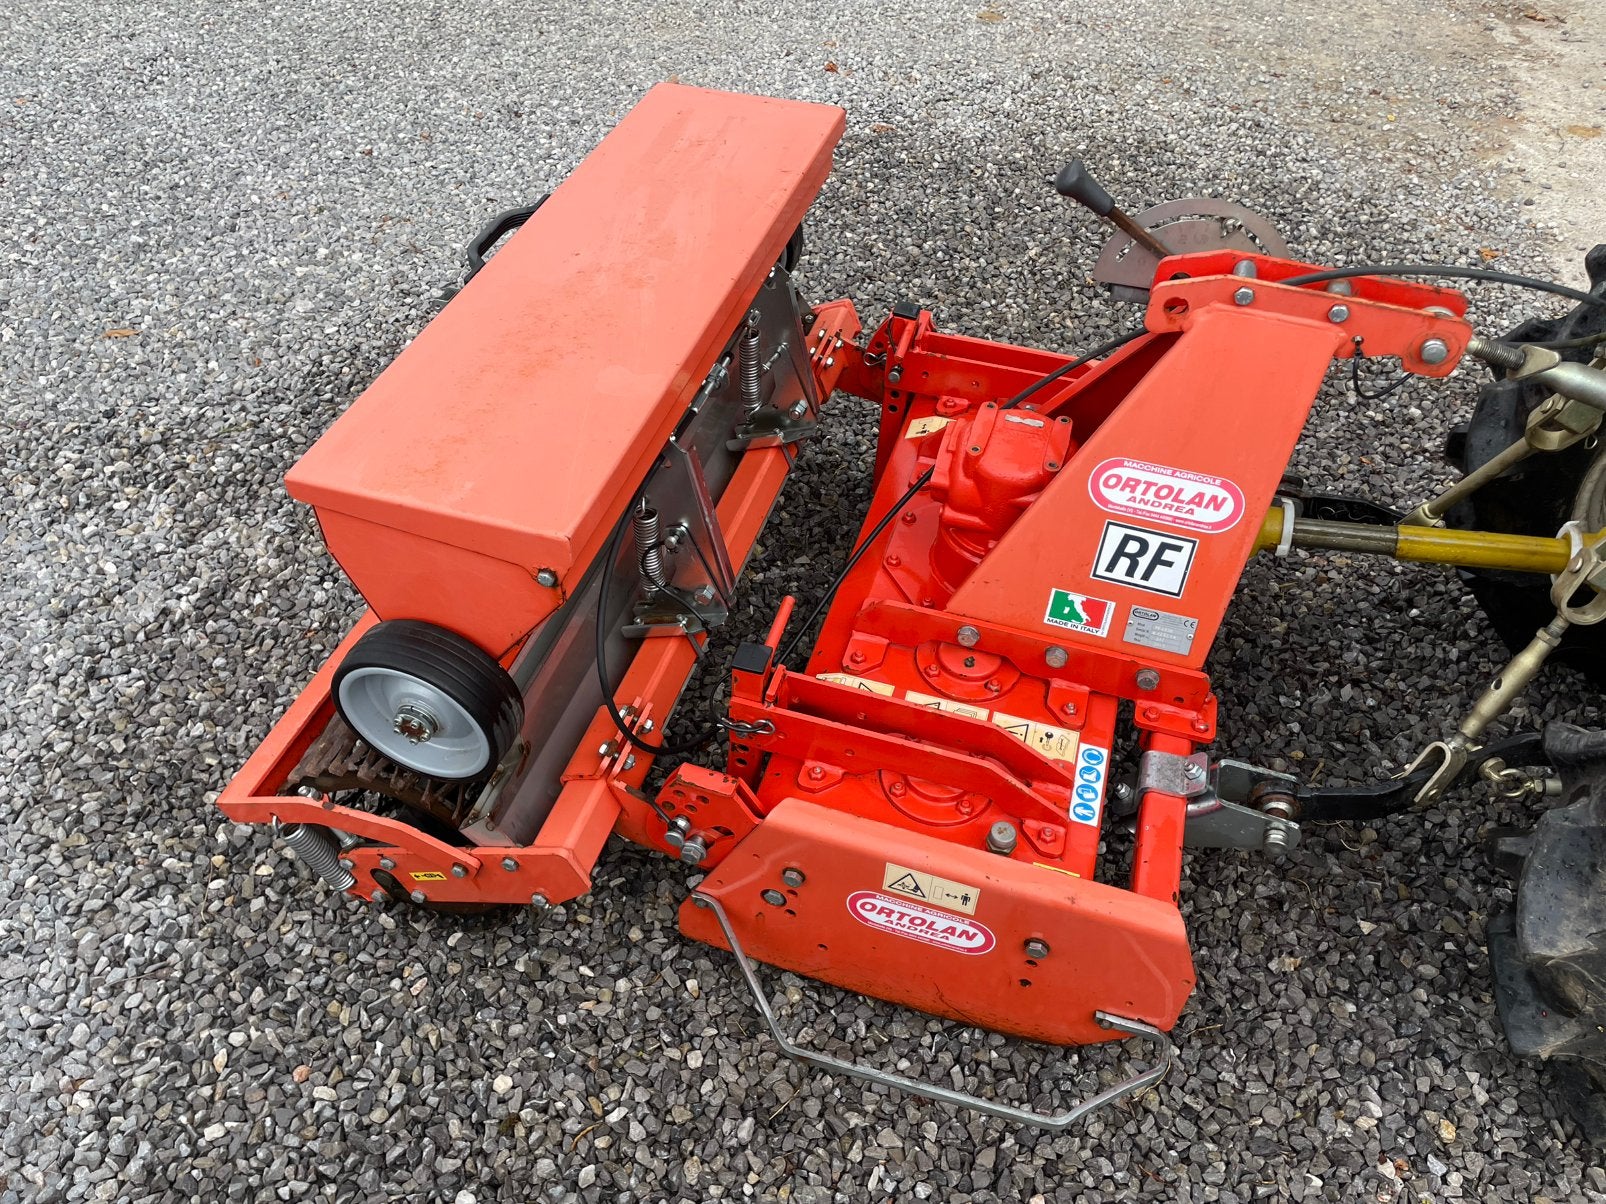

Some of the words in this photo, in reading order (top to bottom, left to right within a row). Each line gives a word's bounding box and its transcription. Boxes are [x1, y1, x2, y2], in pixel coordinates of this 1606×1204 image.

[1123, 460, 1173, 476] MACCHINE
[1173, 470, 1223, 486] AGRICOLE
[1102, 473, 1228, 512] ORTOLAN
[1126, 495, 1195, 516] ANDREA
[1104, 533, 1184, 582] RF
[1046, 617, 1069, 628] MADE
[1080, 625, 1100, 635] ITALY
[859, 901, 978, 942] ORTOLAN
[875, 894, 923, 912] MACCHINE
[924, 909, 971, 926] AGRICOLE
[883, 919, 951, 941] ANDREA
